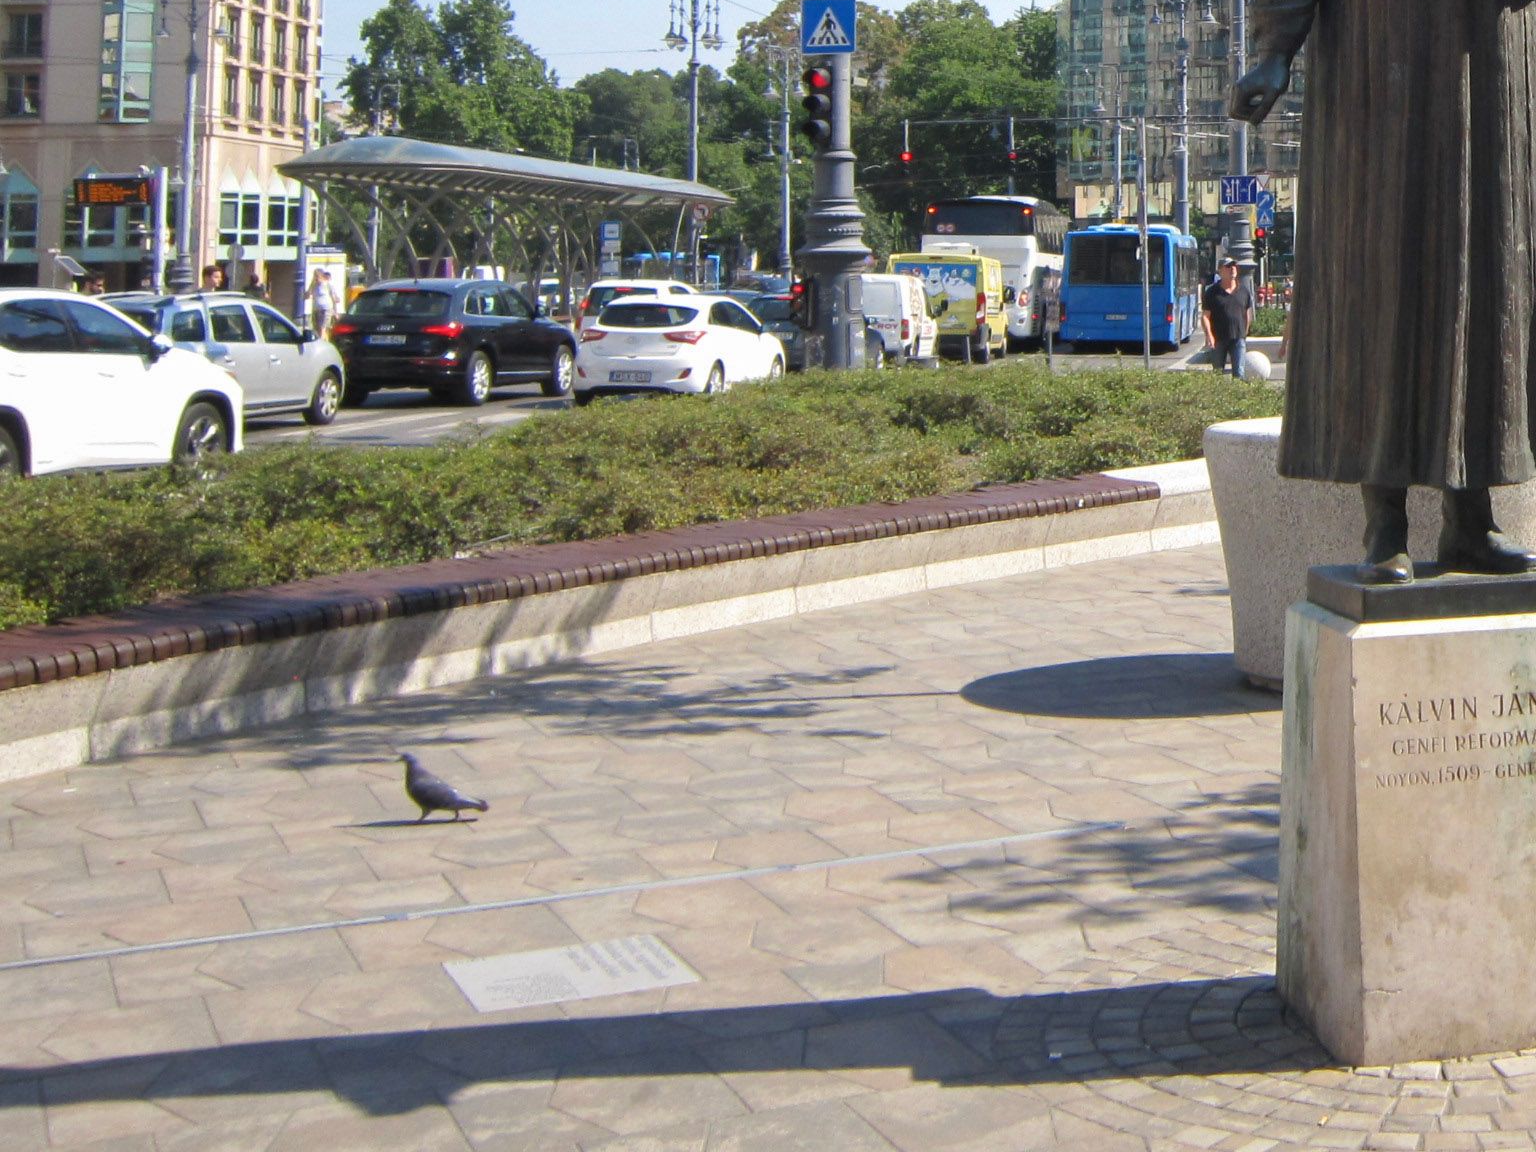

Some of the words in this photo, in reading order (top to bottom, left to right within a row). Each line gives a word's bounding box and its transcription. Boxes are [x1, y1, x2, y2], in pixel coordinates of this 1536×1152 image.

[1379, 693, 1478, 726] KÁLVIN
[1392, 736, 1447, 756] GENFI
[1438, 763, 1480, 784] 1509
